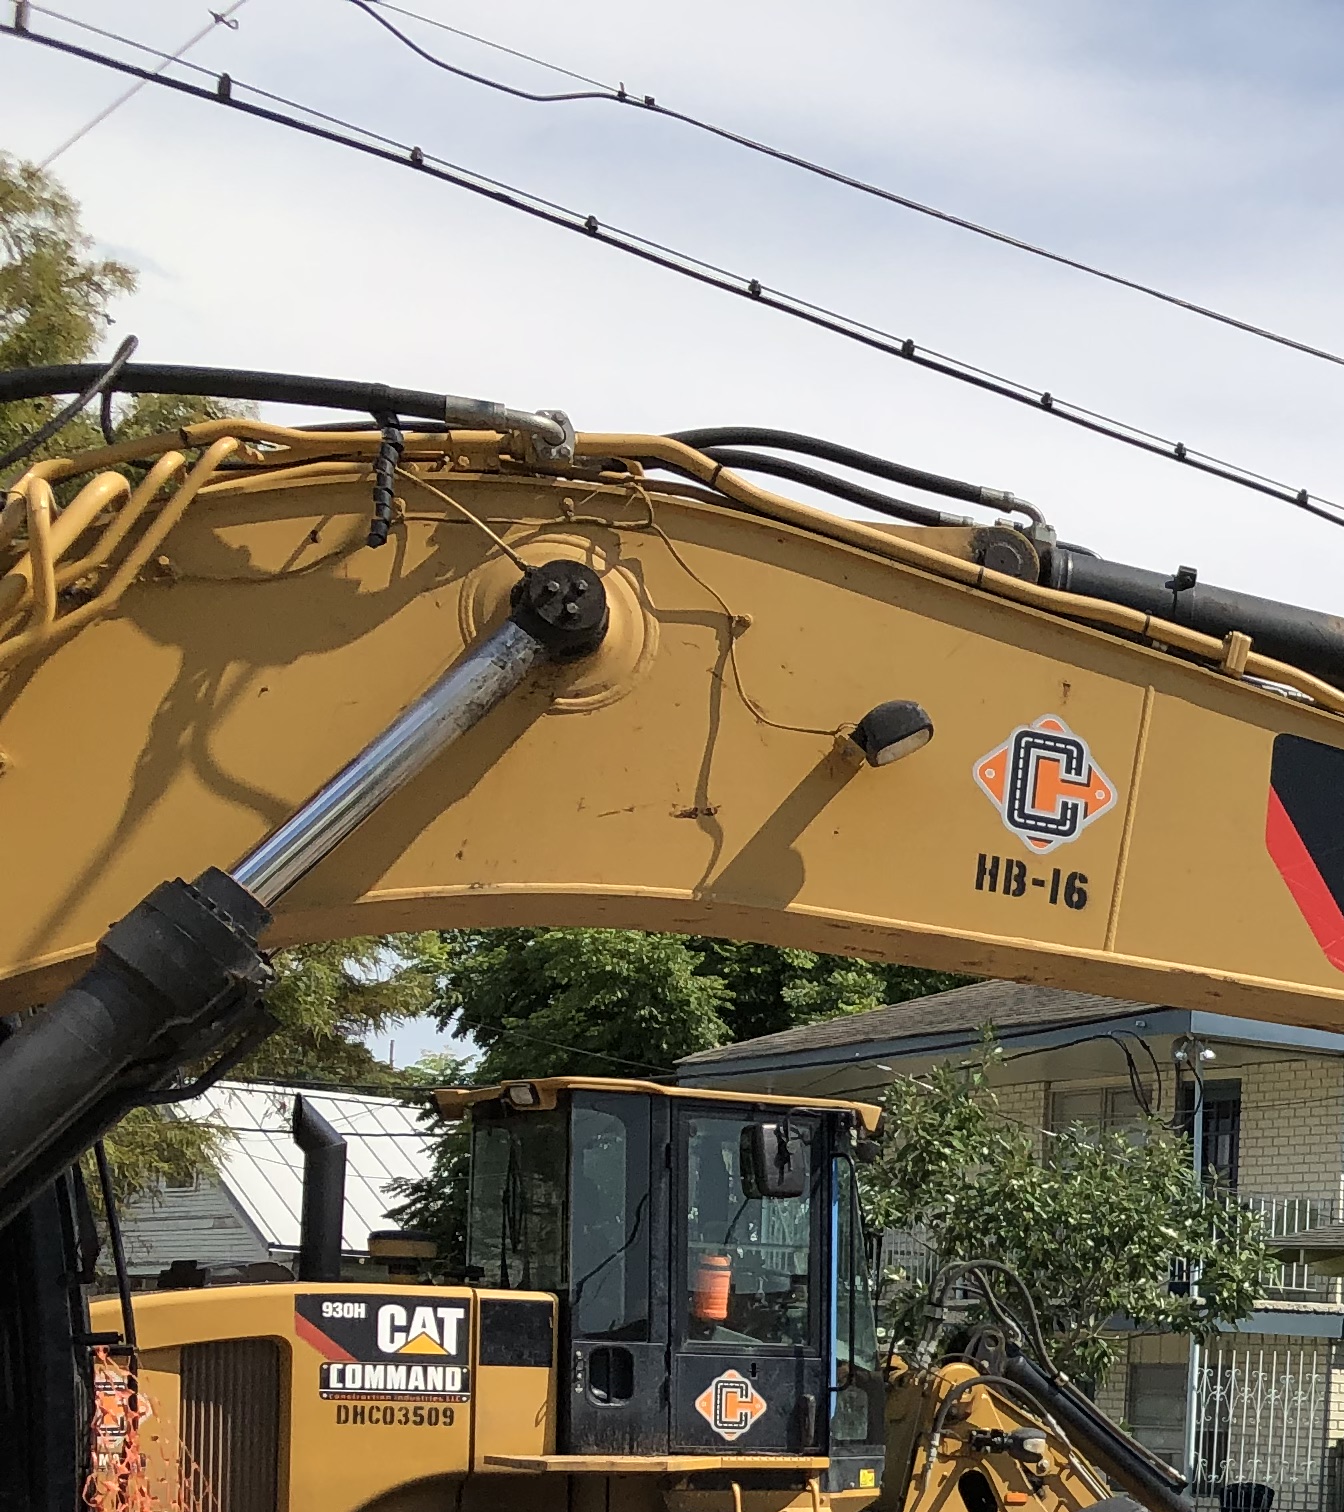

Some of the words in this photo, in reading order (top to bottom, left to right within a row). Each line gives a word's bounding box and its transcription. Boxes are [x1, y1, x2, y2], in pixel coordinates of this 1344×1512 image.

[974, 852, 1089, 911] HB-16
[322, 1302, 366, 1318] 930H
[377, 1304, 465, 1355] CAT
[329, 1364, 462, 1391] COMMAND
[336, 1405, 455, 1426] DHC03509
